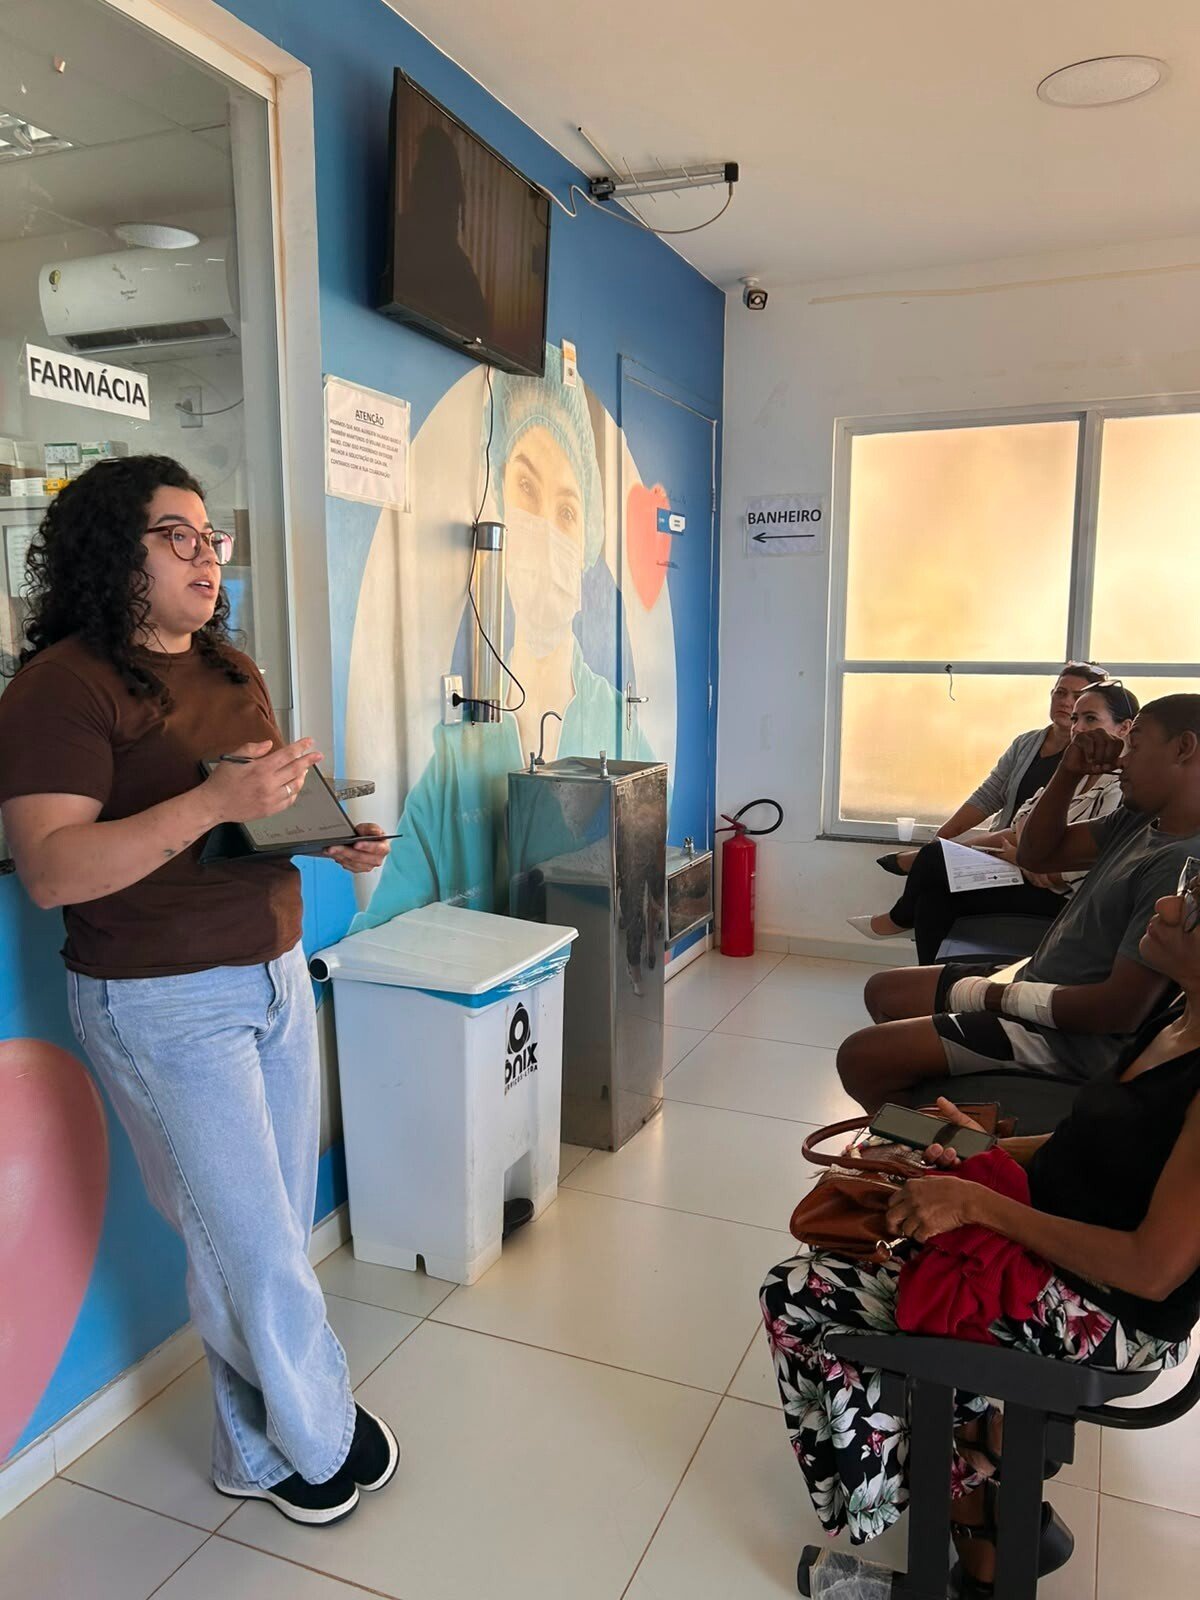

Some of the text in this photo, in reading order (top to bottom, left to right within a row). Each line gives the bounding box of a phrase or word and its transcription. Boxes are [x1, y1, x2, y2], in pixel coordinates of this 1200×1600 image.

[30, 357, 147, 407] FARMÁCIA
[355, 410, 384, 426] ATENÇÃO
[748, 509, 822, 525] BANHEIRO
